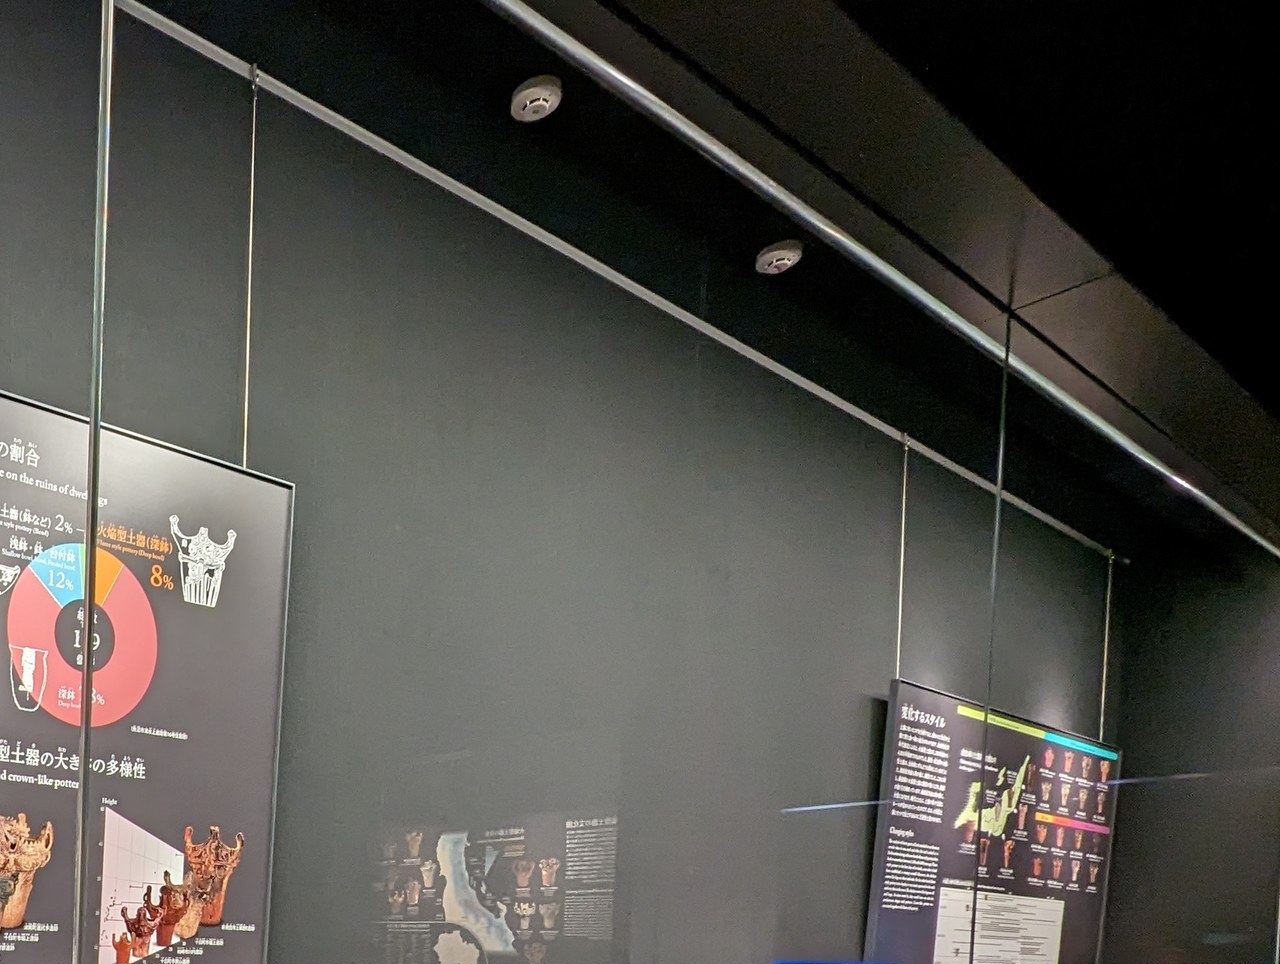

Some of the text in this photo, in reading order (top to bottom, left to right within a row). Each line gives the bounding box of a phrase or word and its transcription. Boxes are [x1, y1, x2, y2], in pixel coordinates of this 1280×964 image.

[6, 472, 18, 480] on
[20, 473, 34, 485] the
[36, 480, 57, 491] ruins
[59, 485, 69, 494] of
[55, 514, 73, 534] 2%
[48, 569, 74, 591] 12%
[150, 564, 174, 590] 8%
[8, 774, 53, 785] crown-like
[54, 780, 80, 792] potter
